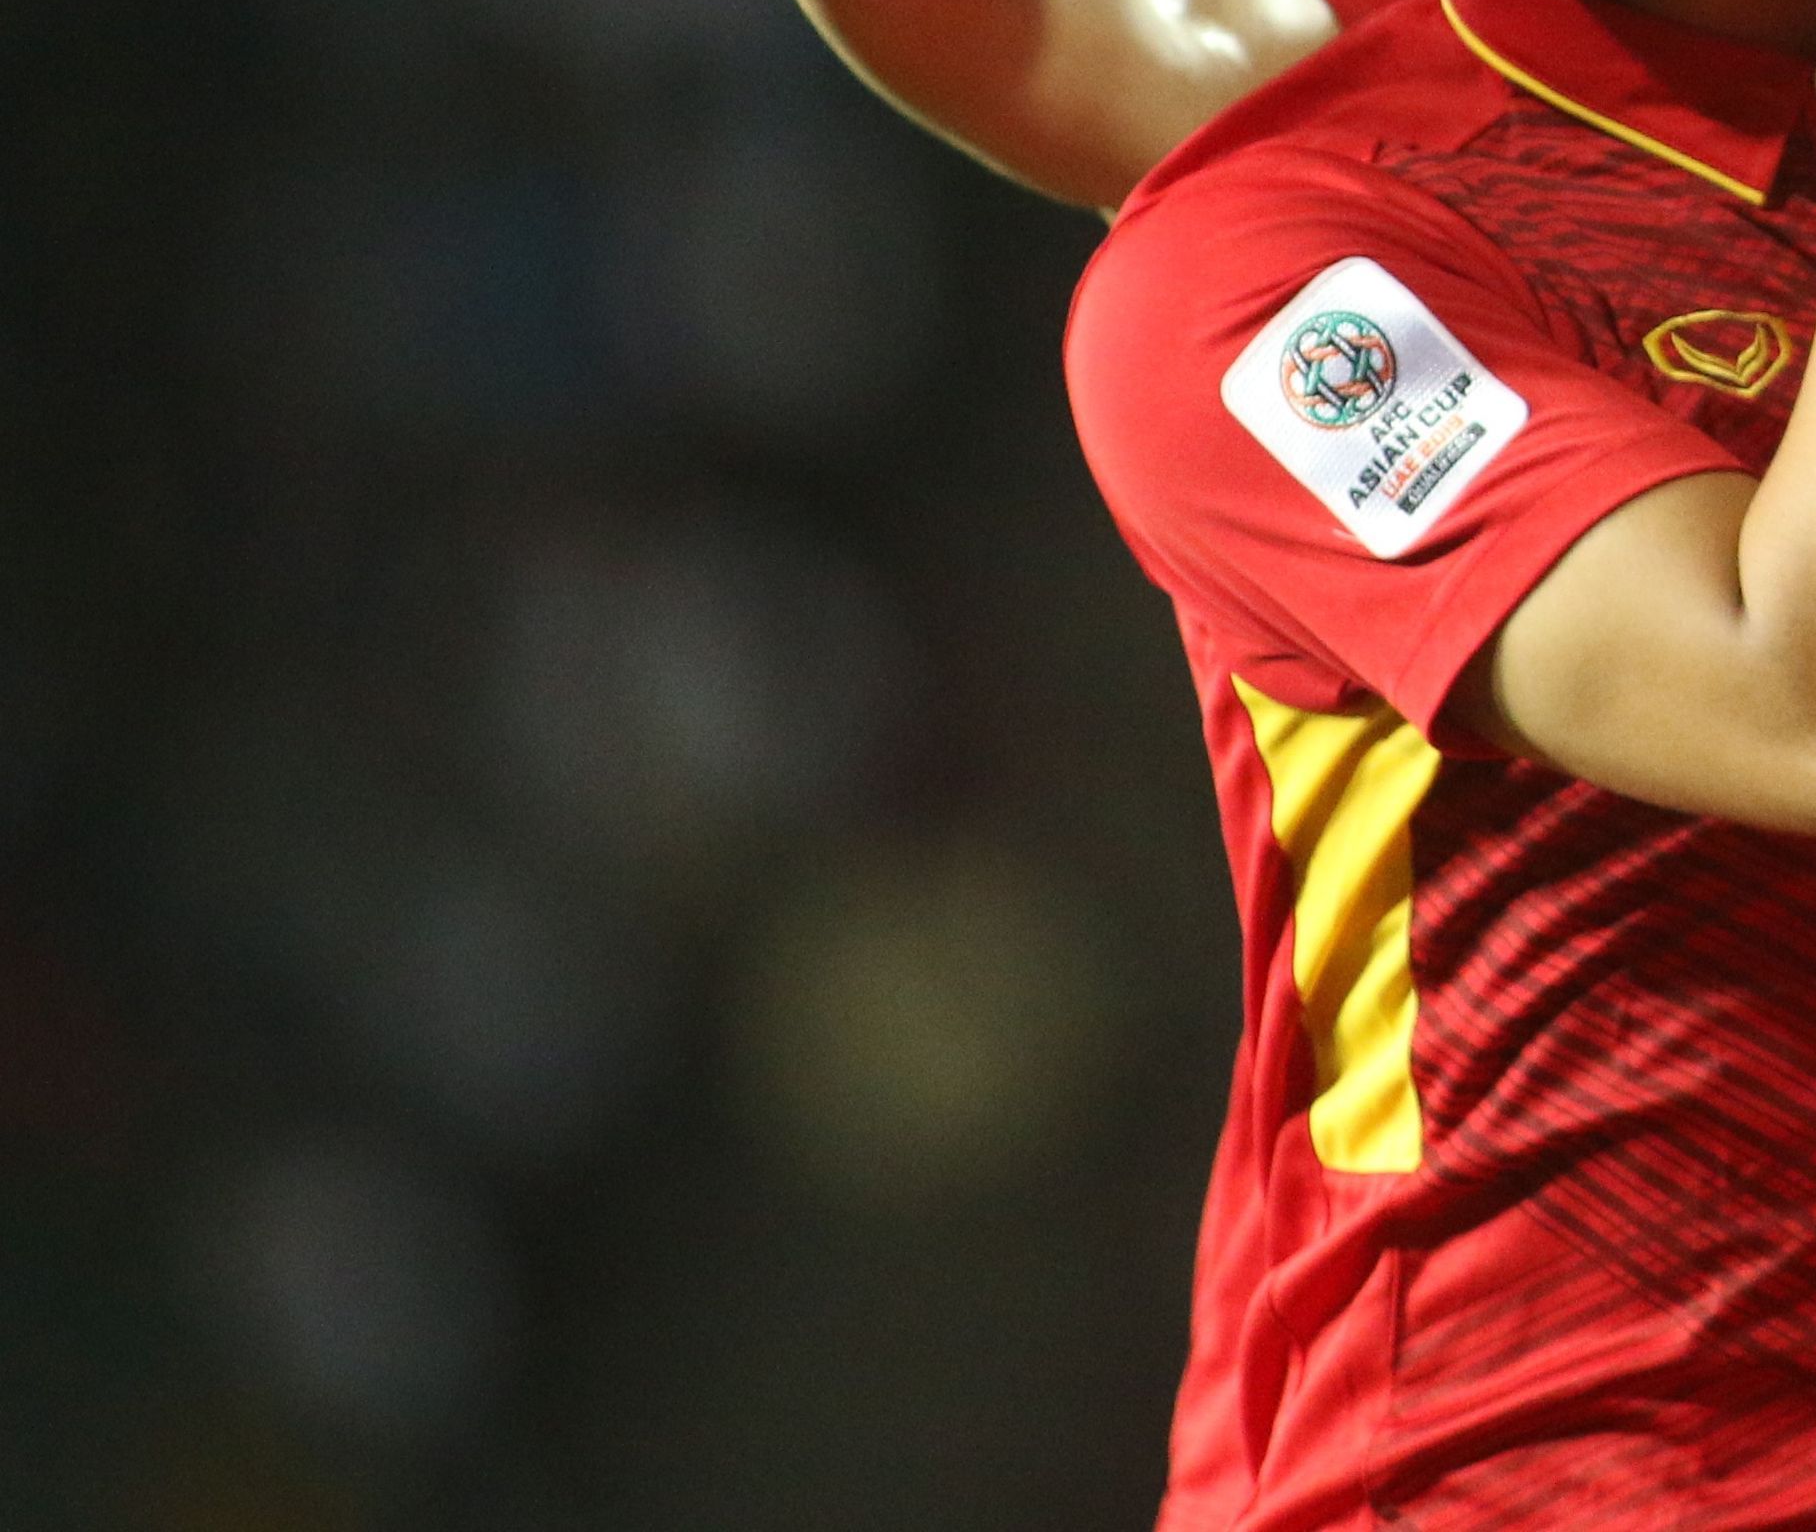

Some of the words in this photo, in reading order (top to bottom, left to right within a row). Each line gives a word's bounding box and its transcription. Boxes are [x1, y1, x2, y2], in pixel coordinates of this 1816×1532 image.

[1348, 425, 1420, 510] ASIAN
[1418, 371, 1473, 428] CUP
[1370, 400, 1412, 444] AFC
[1381, 455, 1421, 499] UAE
[1417, 414, 1465, 458] 2019
